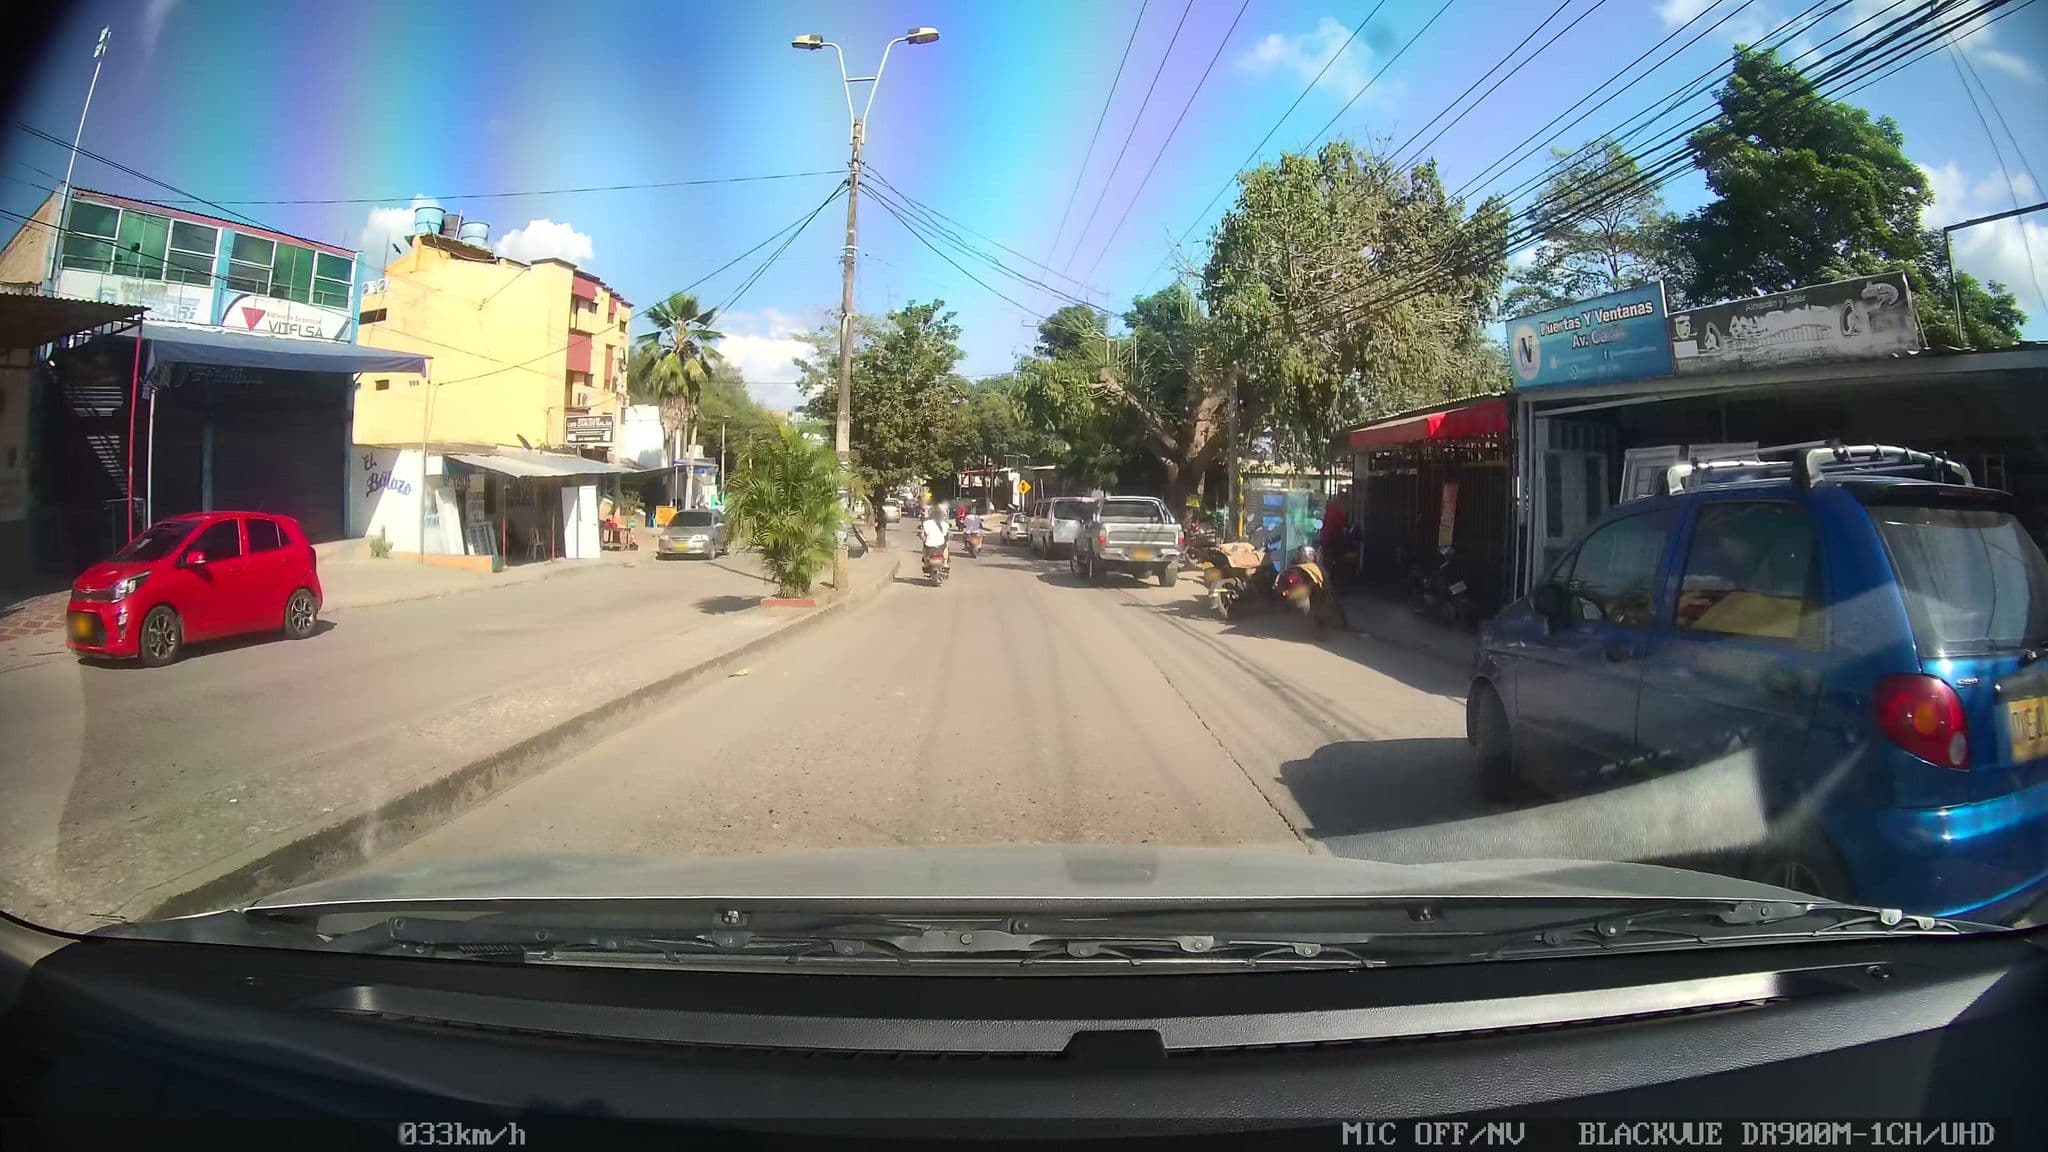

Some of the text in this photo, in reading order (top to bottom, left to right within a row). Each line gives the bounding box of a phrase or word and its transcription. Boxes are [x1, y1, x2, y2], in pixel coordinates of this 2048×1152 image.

[1539, 300, 1653, 336] Puertas Y Ventanas
[1572, 334, 1589, 349] Av.
